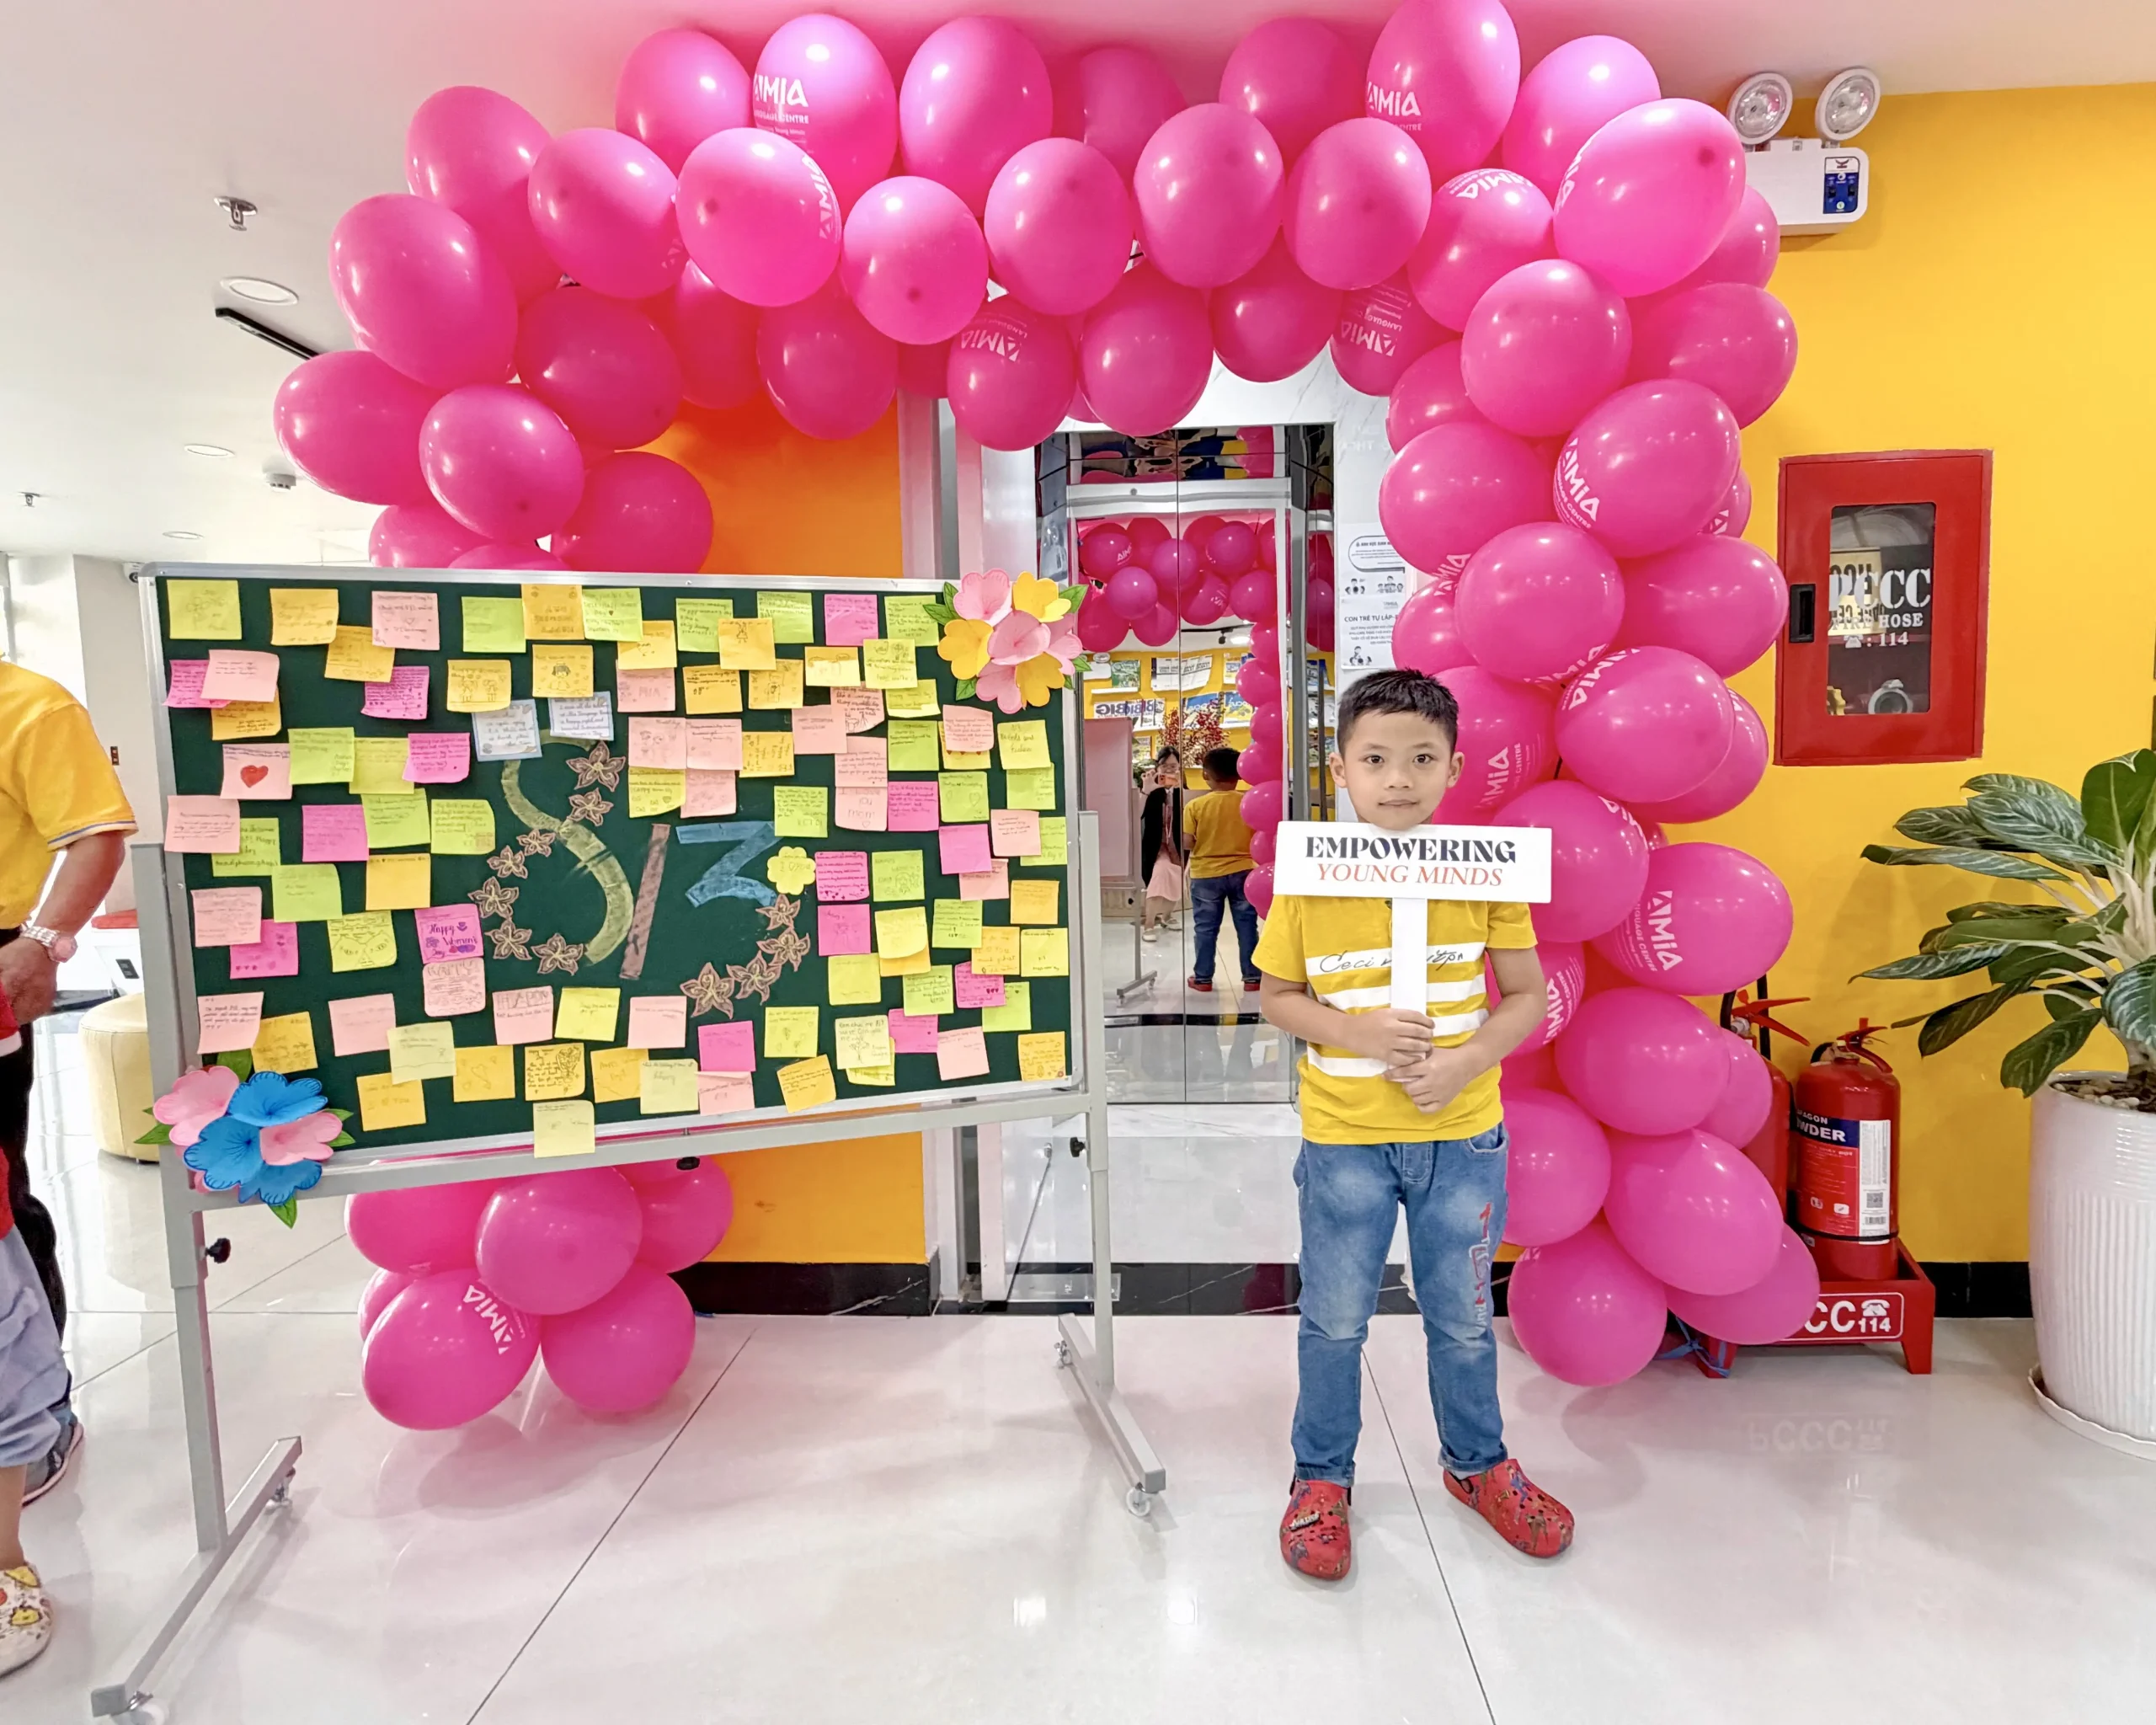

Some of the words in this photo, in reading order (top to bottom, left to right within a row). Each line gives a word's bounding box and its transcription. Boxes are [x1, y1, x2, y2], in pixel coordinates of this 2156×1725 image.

[1828, 568, 1931, 611] PCCC
[1878, 612, 1924, 628] HOSE
[1879, 632, 1909, 647] 114
[1305, 836, 1516, 864] EMPOWERING
[1317, 862, 1409, 884] YOUNG
[1416, 866, 1503, 887] MINDS
[429, 923, 456, 936] Happy
[442, 936, 478, 946] Women's
[1796, 1116, 1847, 1143] WDER
[1858, 1316, 1892, 1333] 114
